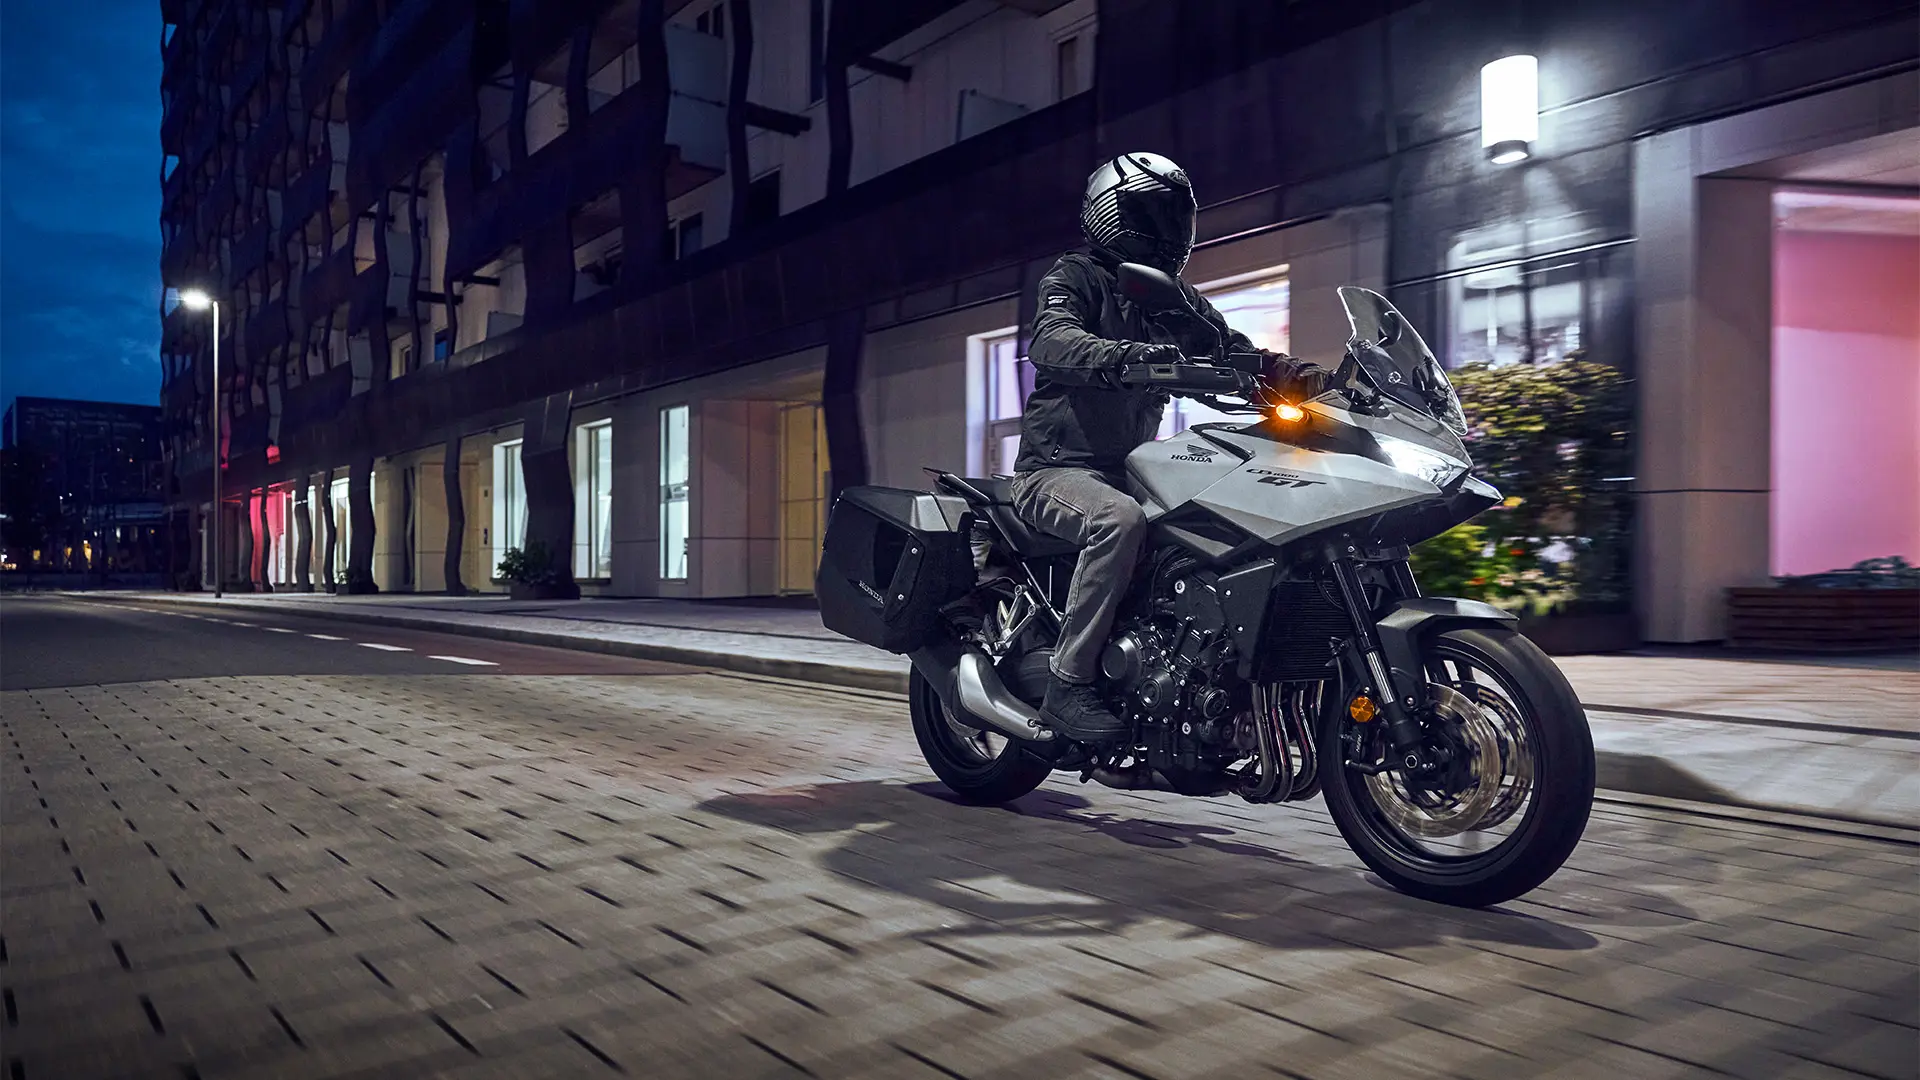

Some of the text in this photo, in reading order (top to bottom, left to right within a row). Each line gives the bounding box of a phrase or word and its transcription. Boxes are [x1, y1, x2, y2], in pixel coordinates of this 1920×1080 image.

[1170, 455, 1213, 463] HONDA
[1257, 476, 1327, 488] GT
[859, 580, 885, 605] HONDA
